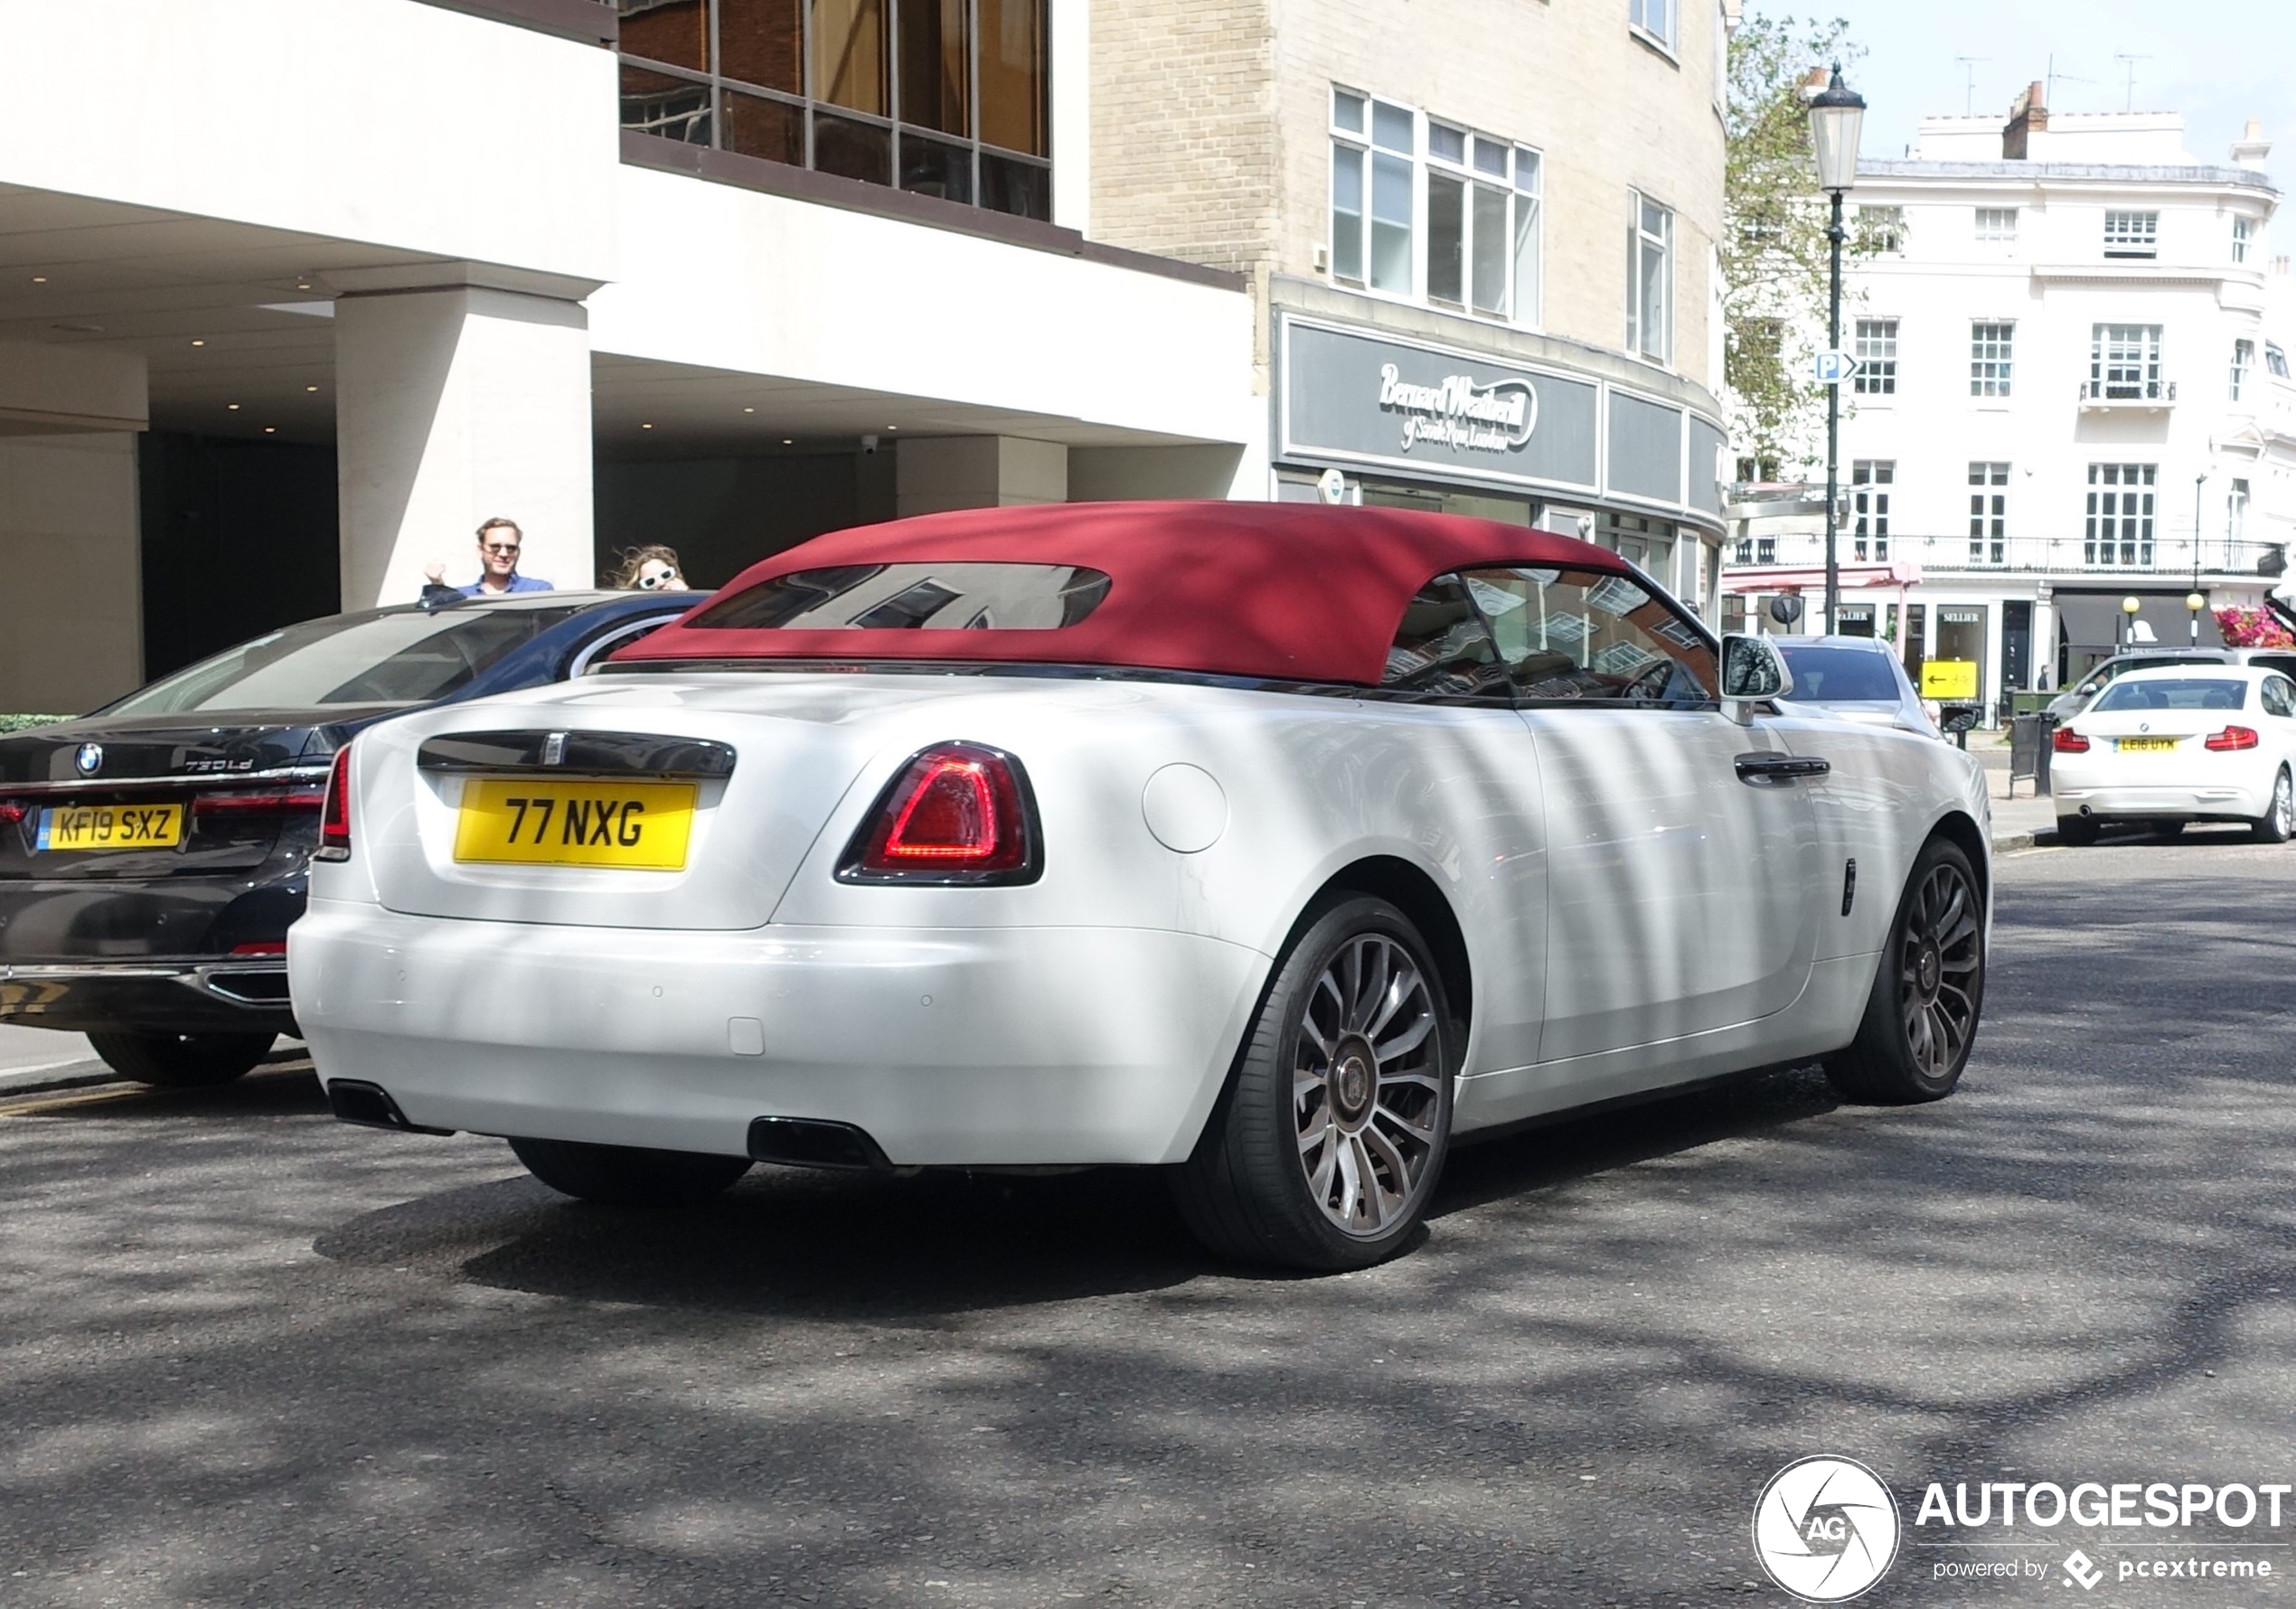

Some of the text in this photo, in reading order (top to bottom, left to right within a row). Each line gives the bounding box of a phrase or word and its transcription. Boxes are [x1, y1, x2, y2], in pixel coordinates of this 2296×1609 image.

[1820, 354, 1837, 379] P
[1379, 363, 1527, 426] Bernard Weatherill
[1401, 417, 1417, 448] of
[1470, 425, 1509, 450] London
[1943, 612, 1979, 622] SELLIER
[2122, 739, 2148, 750] LE16
[59, 809, 172, 842] KF19 SXZ
[506, 798, 645, 847] 77 NXG
